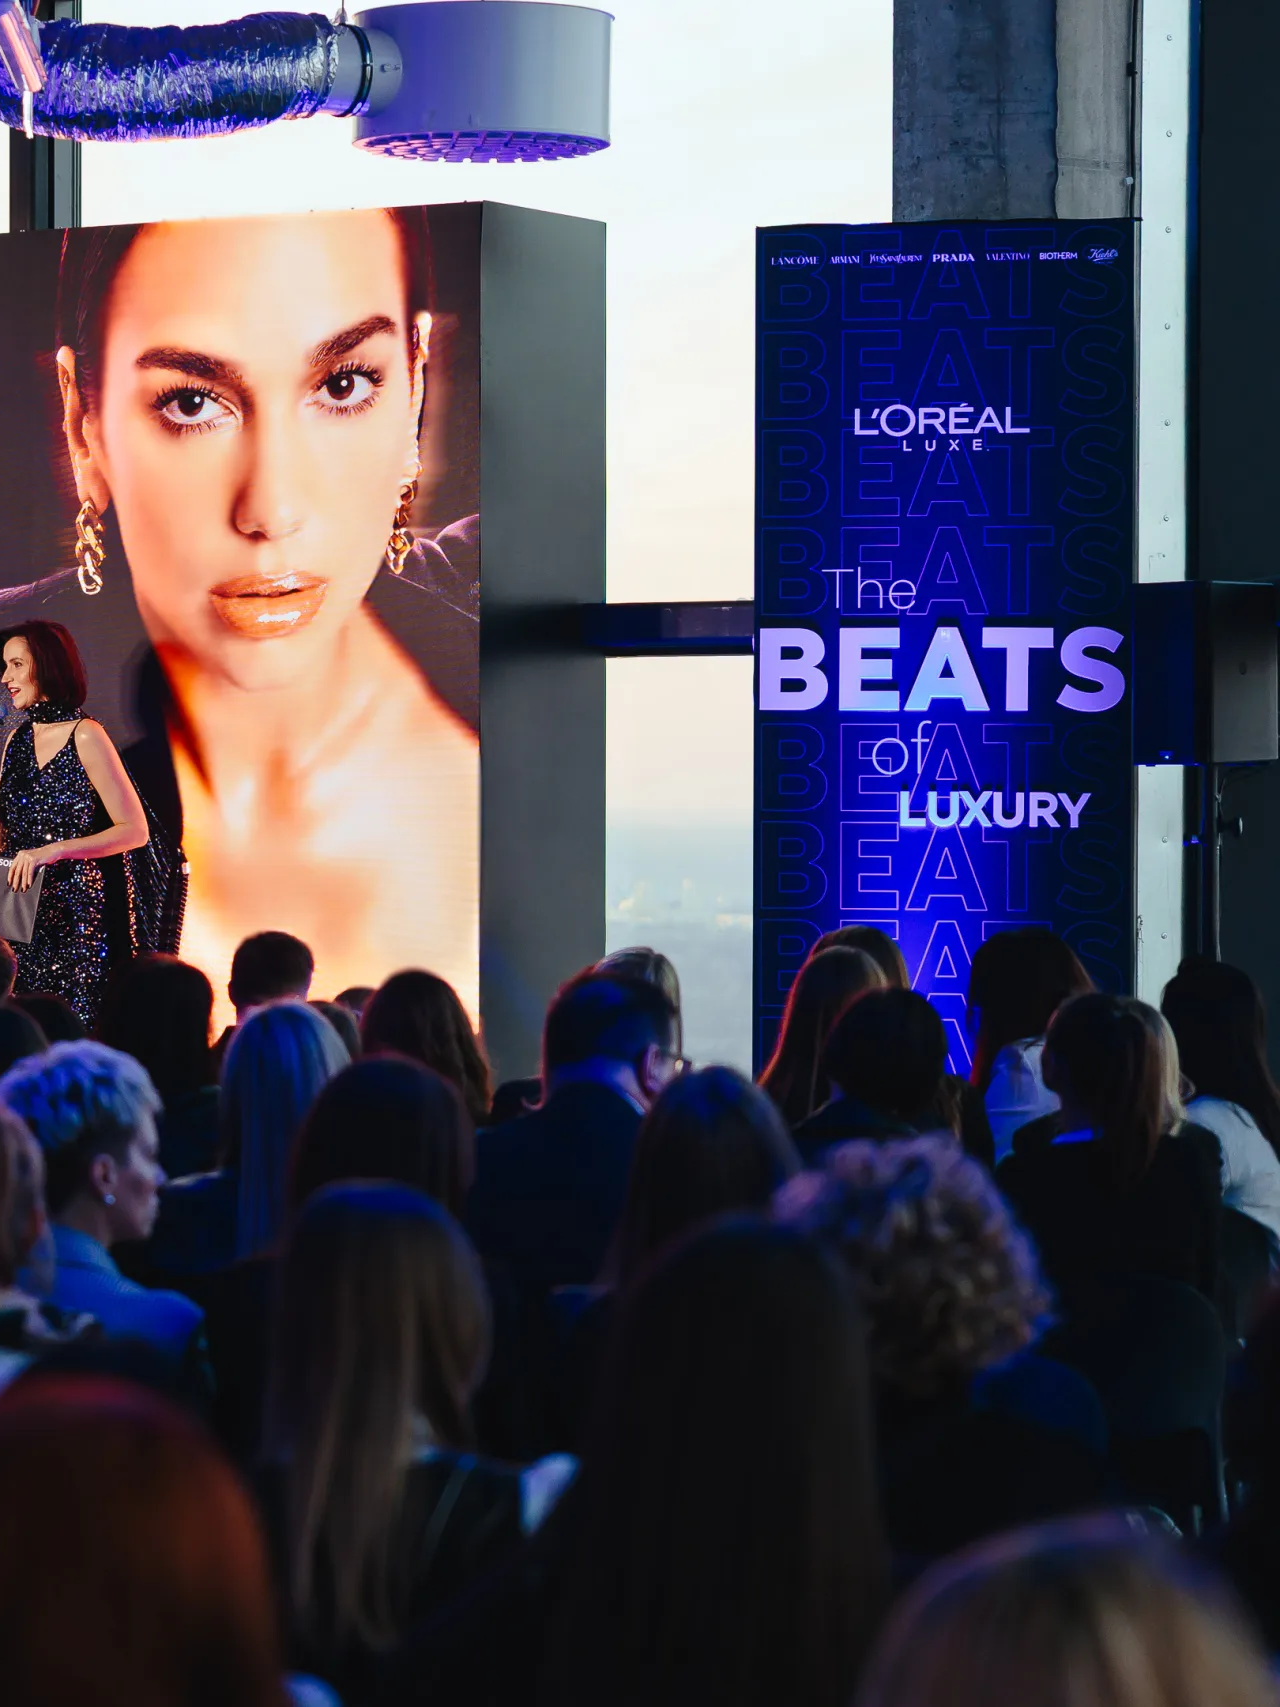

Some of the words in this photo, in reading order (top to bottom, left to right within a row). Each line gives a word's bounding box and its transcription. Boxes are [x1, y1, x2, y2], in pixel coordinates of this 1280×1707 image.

[771, 255, 819, 266] LANCÔME
[830, 255, 860, 265] ARMANI
[932, 253, 975, 263] PRADA
[986, 253, 1030, 261] VALENTINO
[1039, 252, 1078, 260] BIOTHERM
[854, 403, 1030, 437] L'ORÉAL
[821, 566, 916, 610] The
[758, 626, 1126, 712] BEATS
[872, 720, 932, 775] of
[899, 790, 1091, 829] LUXURY
